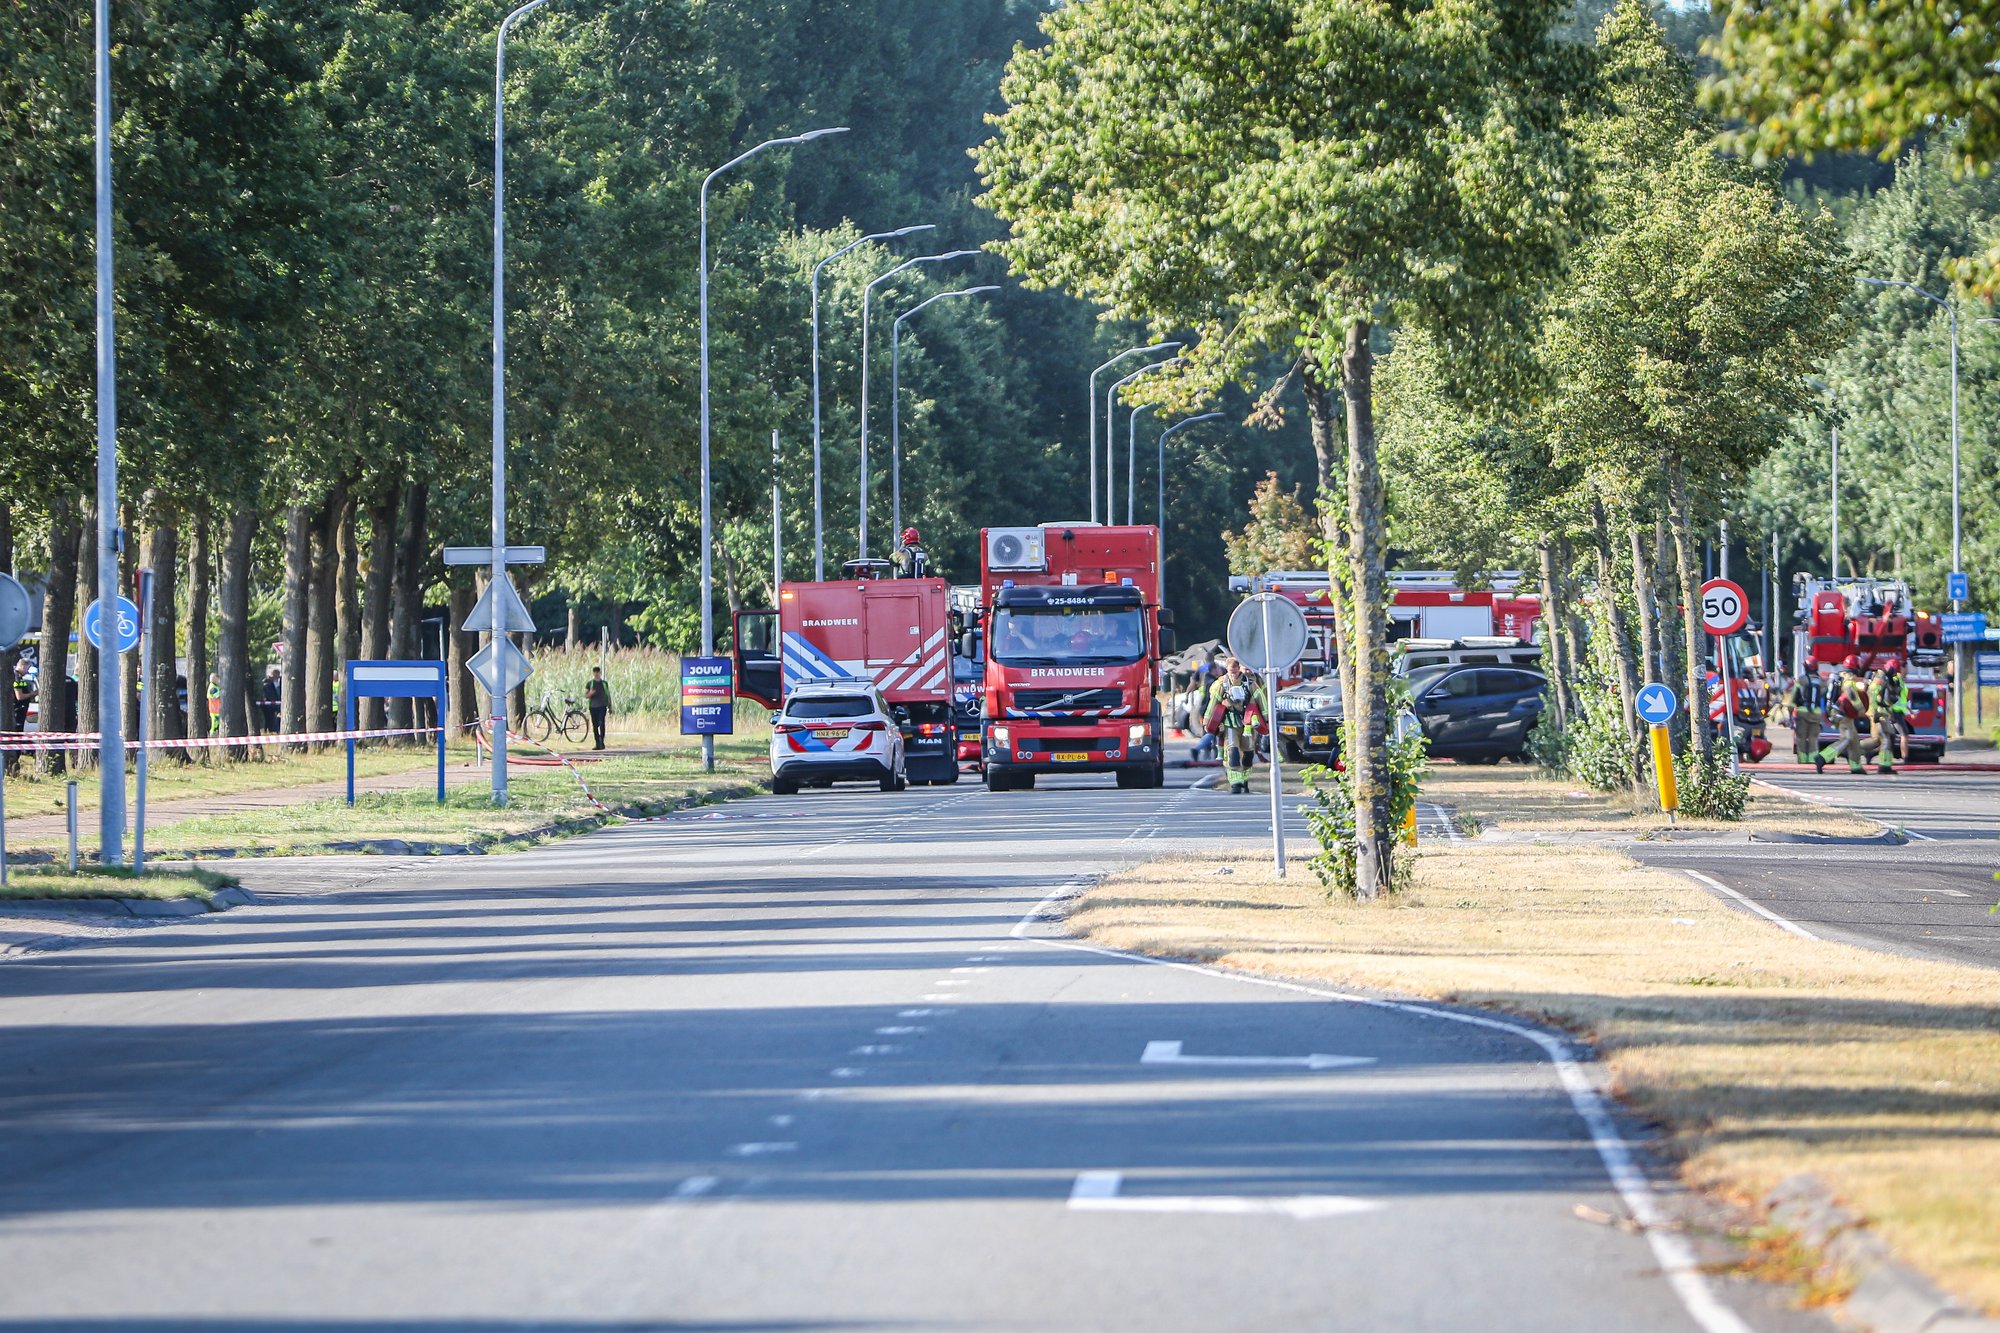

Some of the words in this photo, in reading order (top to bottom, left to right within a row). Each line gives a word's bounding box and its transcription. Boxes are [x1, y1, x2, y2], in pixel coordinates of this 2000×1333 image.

[1704, 597, 1738, 618] 50
[802, 618, 858, 627] BRANDWEER
[1504, 613, 1514, 636] 25-5
[689, 666, 722, 675] JOUW
[1030, 667, 1105, 677] BRANDWEER
[691, 706, 721, 716] HIER?
